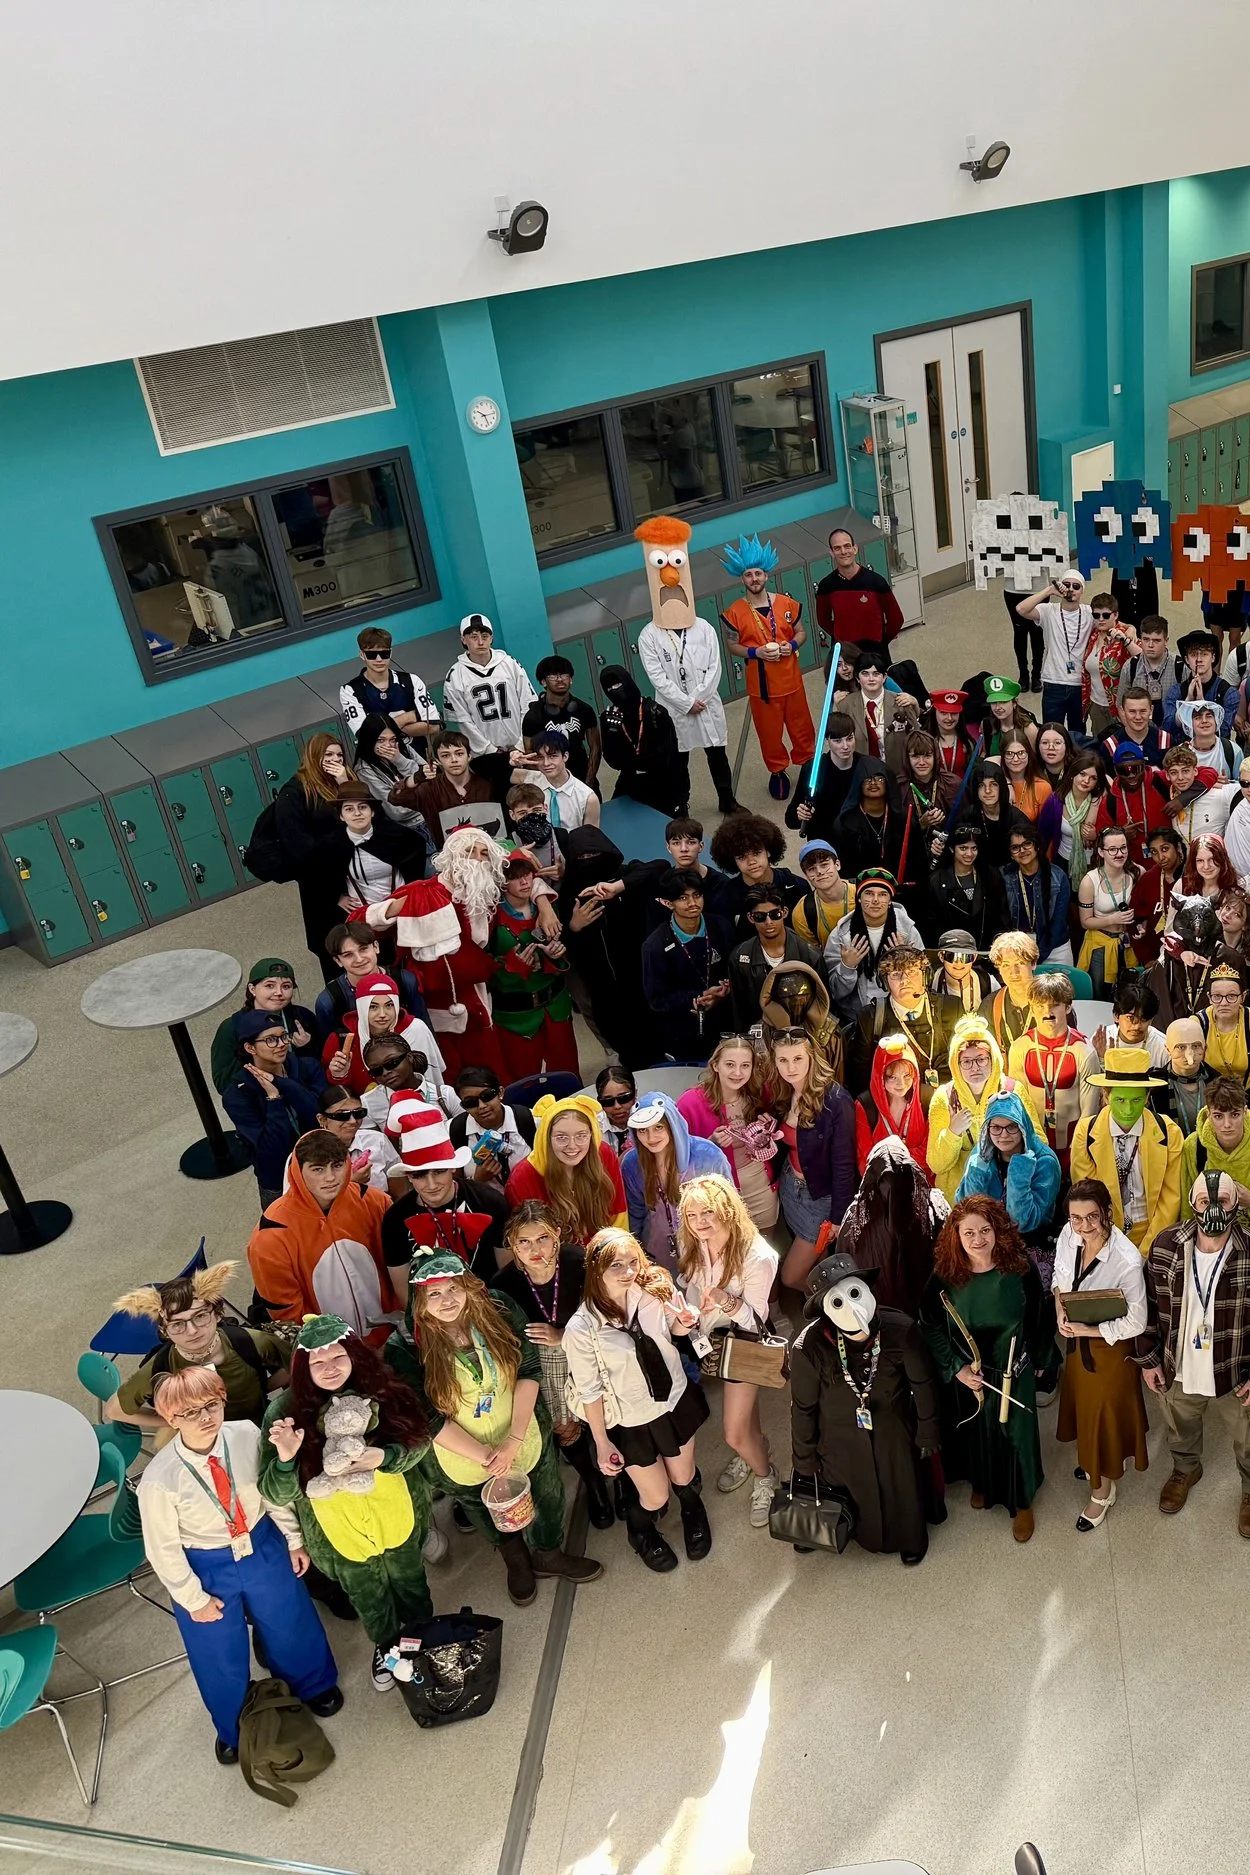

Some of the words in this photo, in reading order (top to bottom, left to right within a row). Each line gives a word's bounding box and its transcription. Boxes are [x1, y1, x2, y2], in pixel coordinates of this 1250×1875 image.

[303, 581, 336, 599] M300
[993, 679, 1001, 689] L
[471, 681, 511, 722] 21
